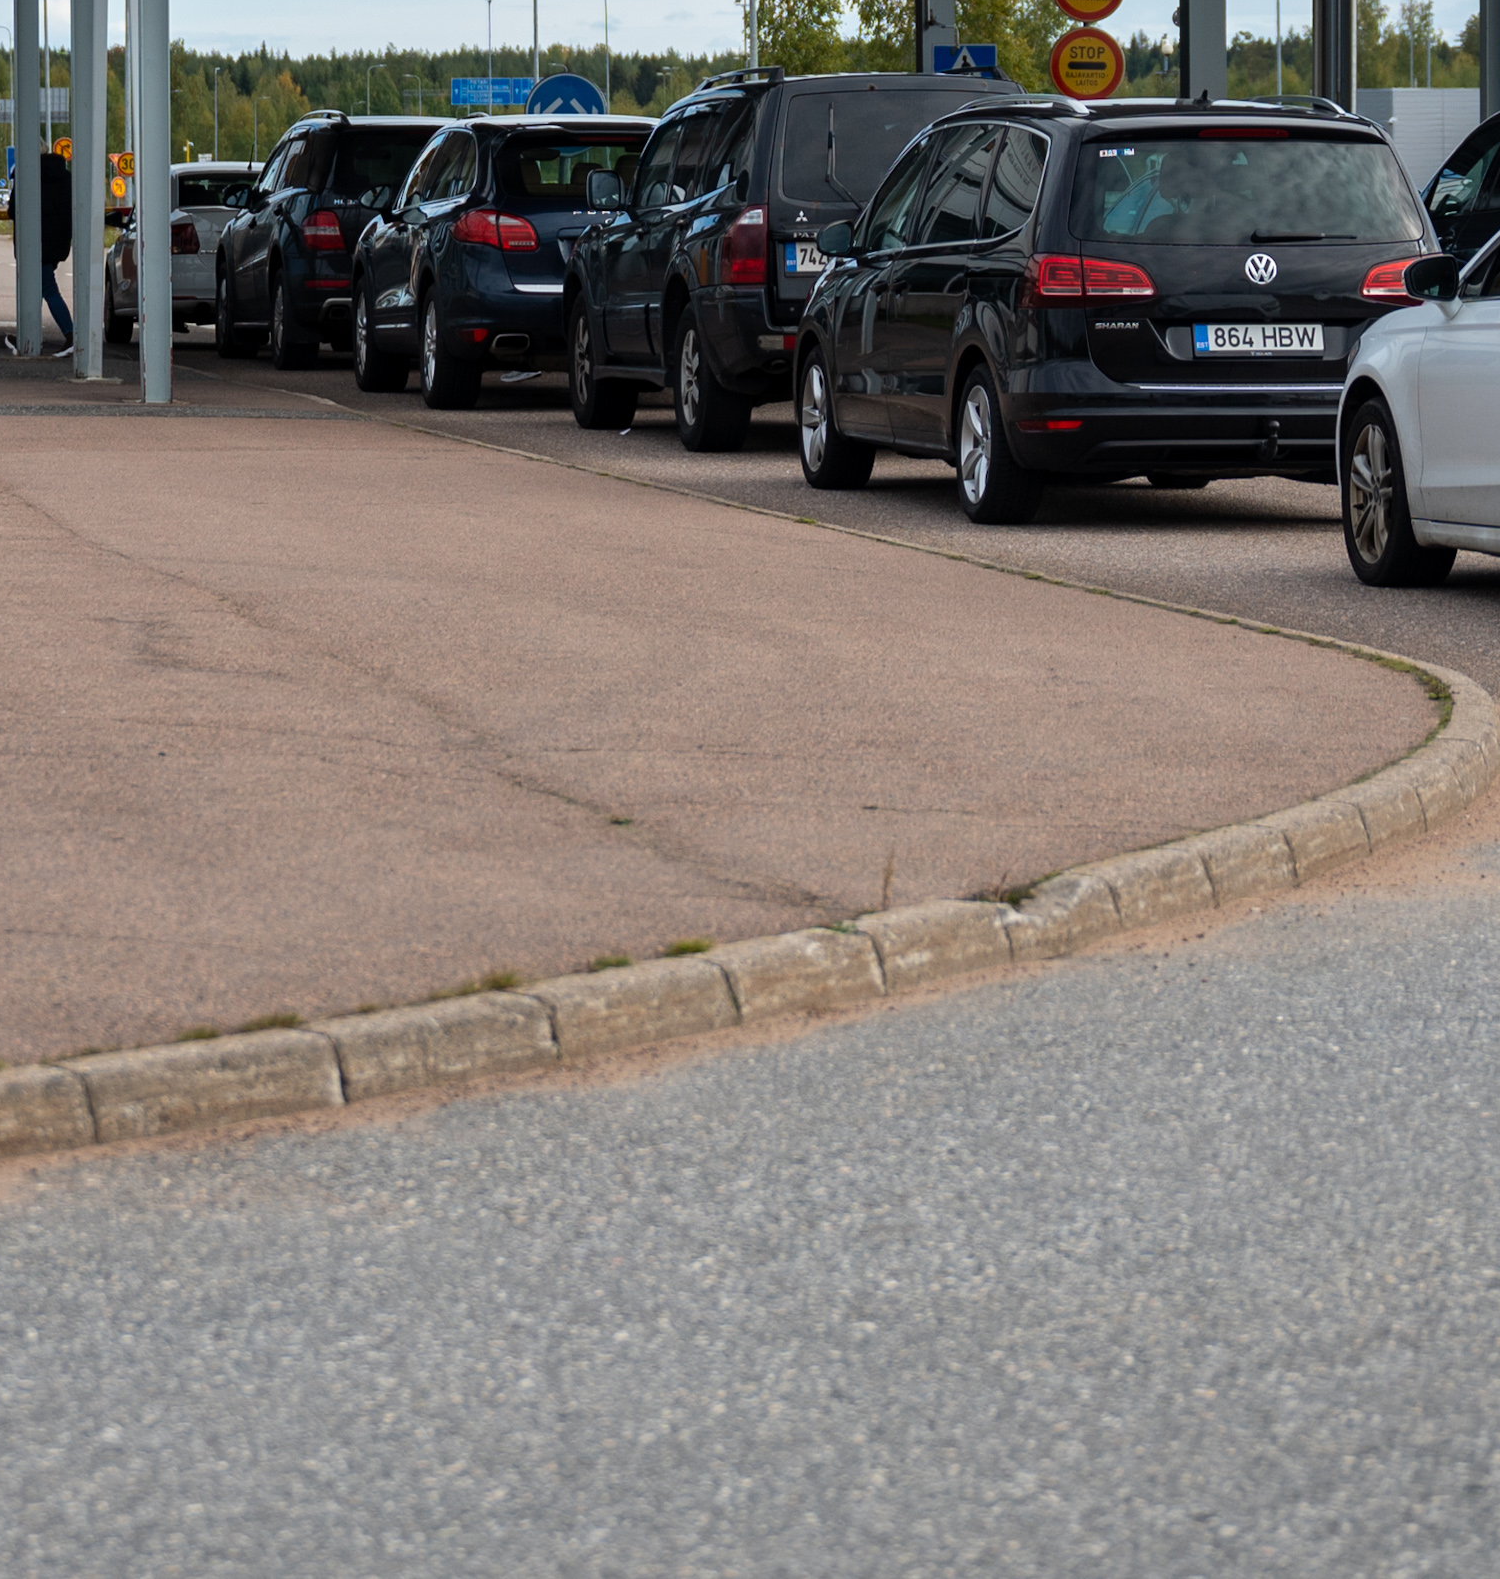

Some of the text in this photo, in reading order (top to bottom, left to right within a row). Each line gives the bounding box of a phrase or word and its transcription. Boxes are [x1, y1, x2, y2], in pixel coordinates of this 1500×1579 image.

[1070, 46, 1106, 59] STOP
[122, 158, 134, 171] 30
[1214, 326, 1316, 347] 864 HBW
